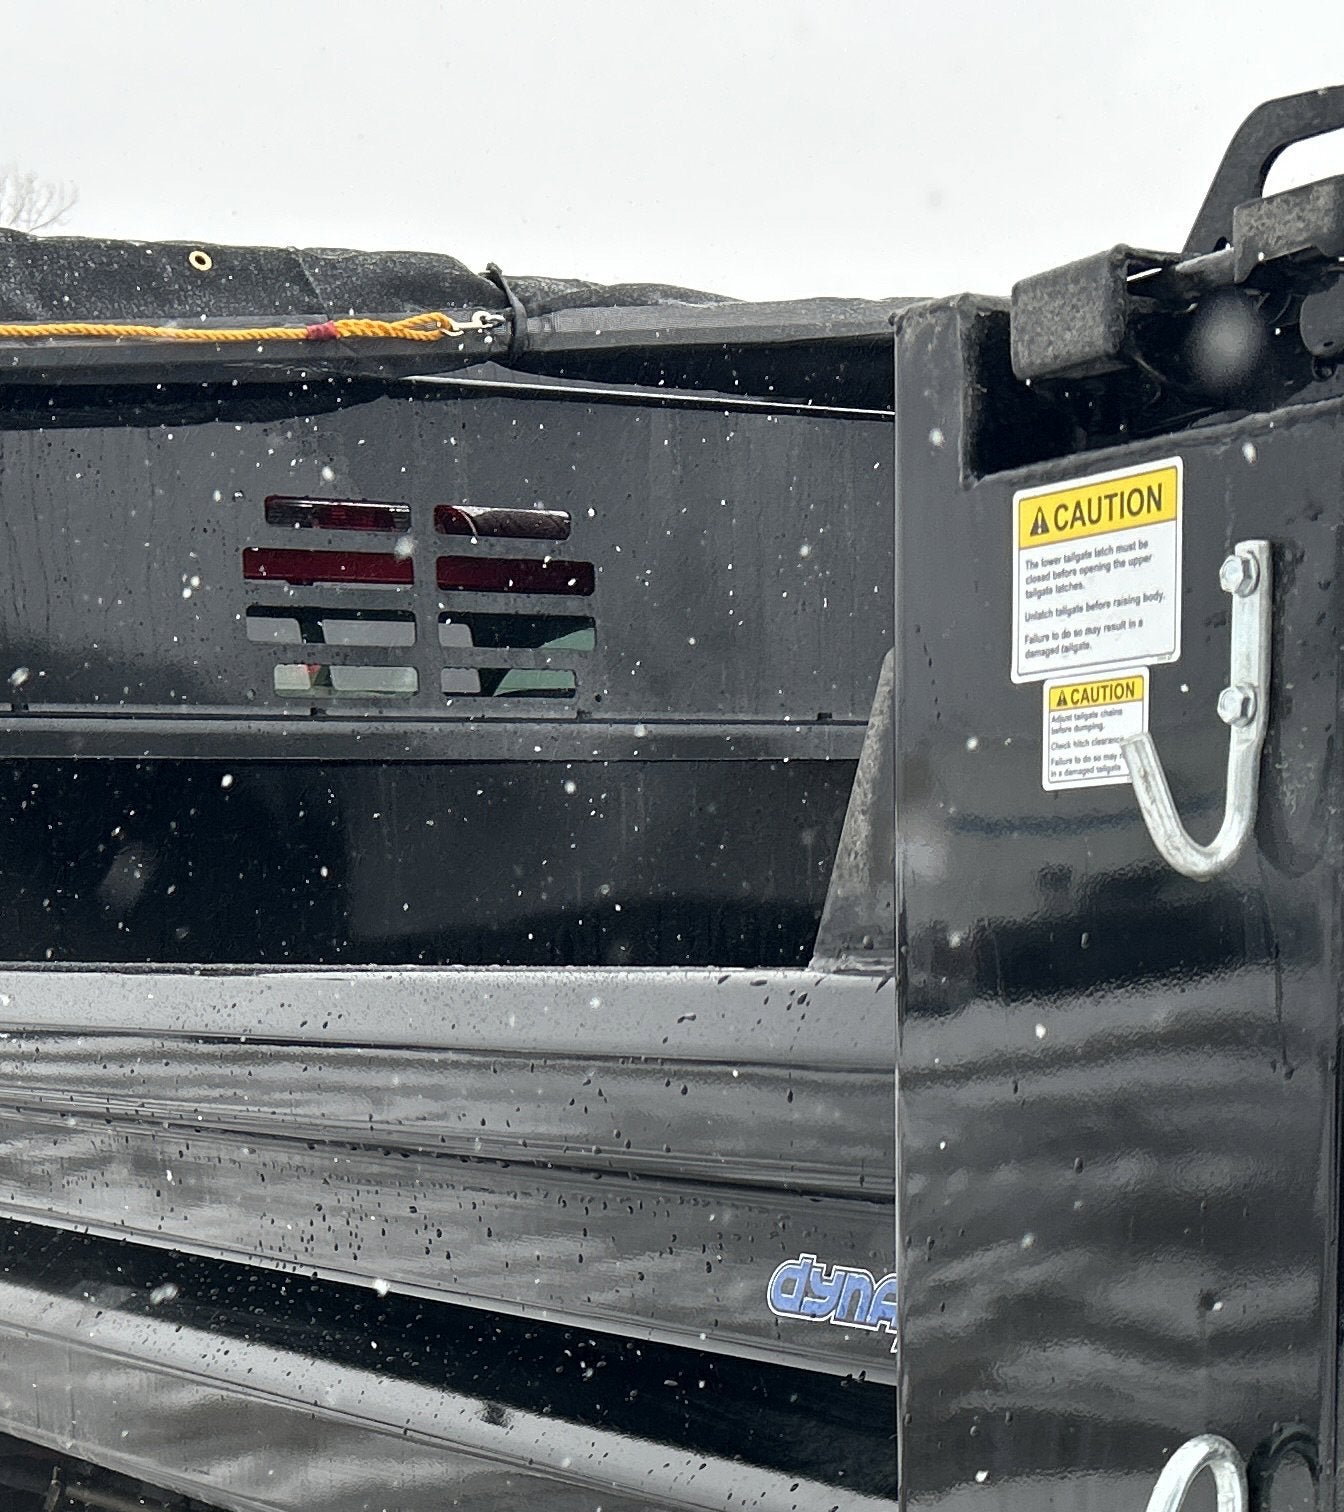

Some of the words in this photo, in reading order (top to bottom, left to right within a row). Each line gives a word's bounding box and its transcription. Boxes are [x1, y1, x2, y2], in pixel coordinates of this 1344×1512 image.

[1054, 482, 1163, 531] CAUTION
[1026, 560, 1039, 570] The
[1041, 556, 1061, 567] lower
[1064, 551, 1092, 563] tailgate
[1095, 547, 1113, 557] latch
[1116, 542, 1136, 553] must
[1138, 540, 1149, 549] be
[1026, 572, 1050, 584] closed
[1053, 569, 1077, 580] before
[1079, 562, 1111, 576] opening
[1114, 558, 1126, 568] the
[1128, 555, 1152, 568] upper
[1026, 587, 1053, 599] tailgate
[1025, 608, 1053, 622] Unlatch
[1056, 605, 1084, 617] tailgate
[1086, 600, 1110, 612] before
[1113, 595, 1140, 607] raising
[1143, 590, 1165, 603] body.
[1025, 633, 1049, 645] Failure
[1052, 630, 1059, 640] to
[1061, 628, 1071, 639] do
[1074, 628, 1083, 636] so
[1085, 625, 1101, 637] may
[1104, 621, 1126, 632] result
[1129, 619, 1136, 629] in
[1025, 645, 1059, 659] damaged
[1070, 681, 1135, 706] CAUTION
[1074, 711, 1098, 722] tailgate
[1051, 742, 1071, 751] Check
[1051, 757, 1072, 766] Failure
[1064, 766, 1094, 777] damaged
[768, 1254, 897, 1332] dyna
